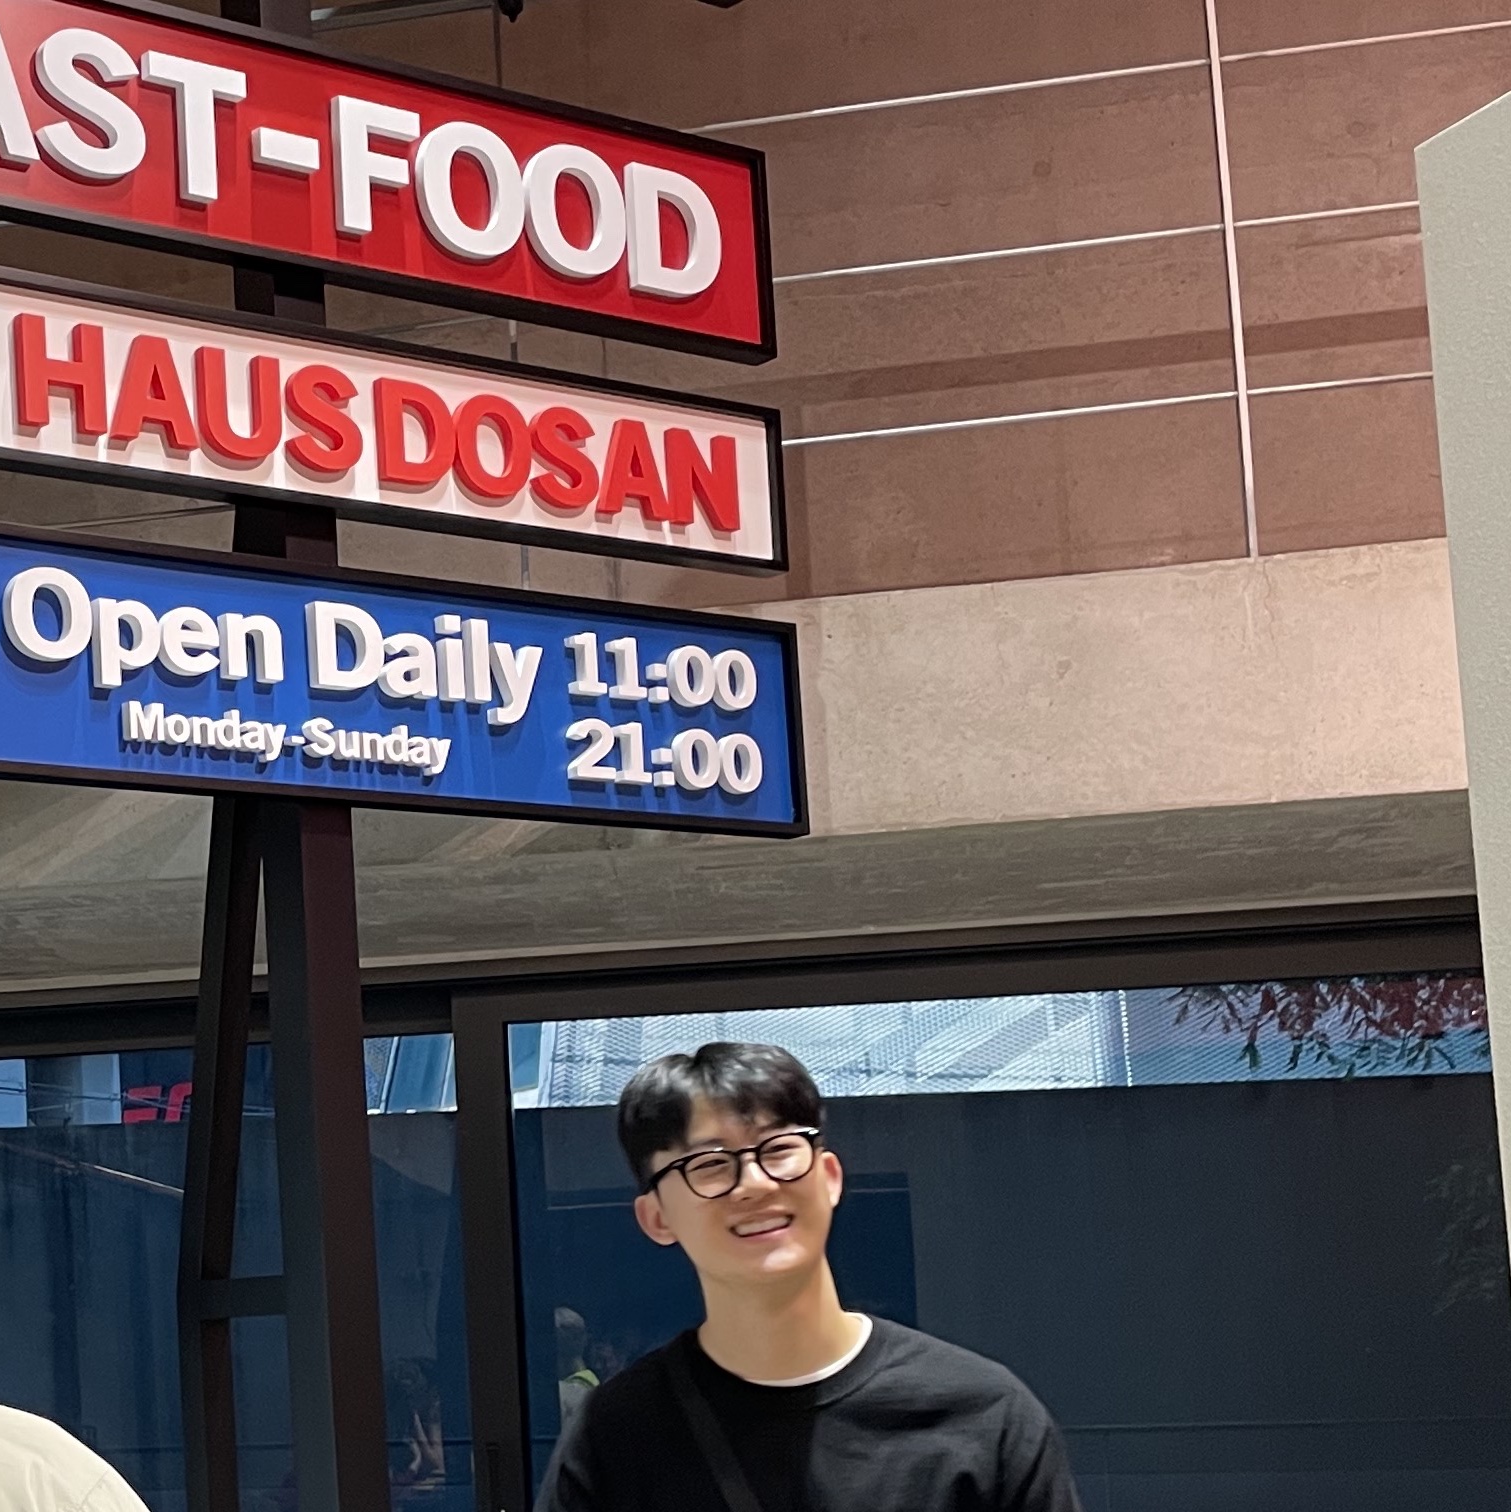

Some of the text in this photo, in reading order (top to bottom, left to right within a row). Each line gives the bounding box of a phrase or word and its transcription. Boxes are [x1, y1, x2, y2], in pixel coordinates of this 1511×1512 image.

[13, 313, 362, 473] HAUS
[373, 378, 741, 531] DOSAN
[4, 566, 543, 725] Open Daily
[565, 632, 757, 711] 11:00
[122, 701, 451, 776] Monday-Sunday
[567, 718, 763, 794] 21:00
